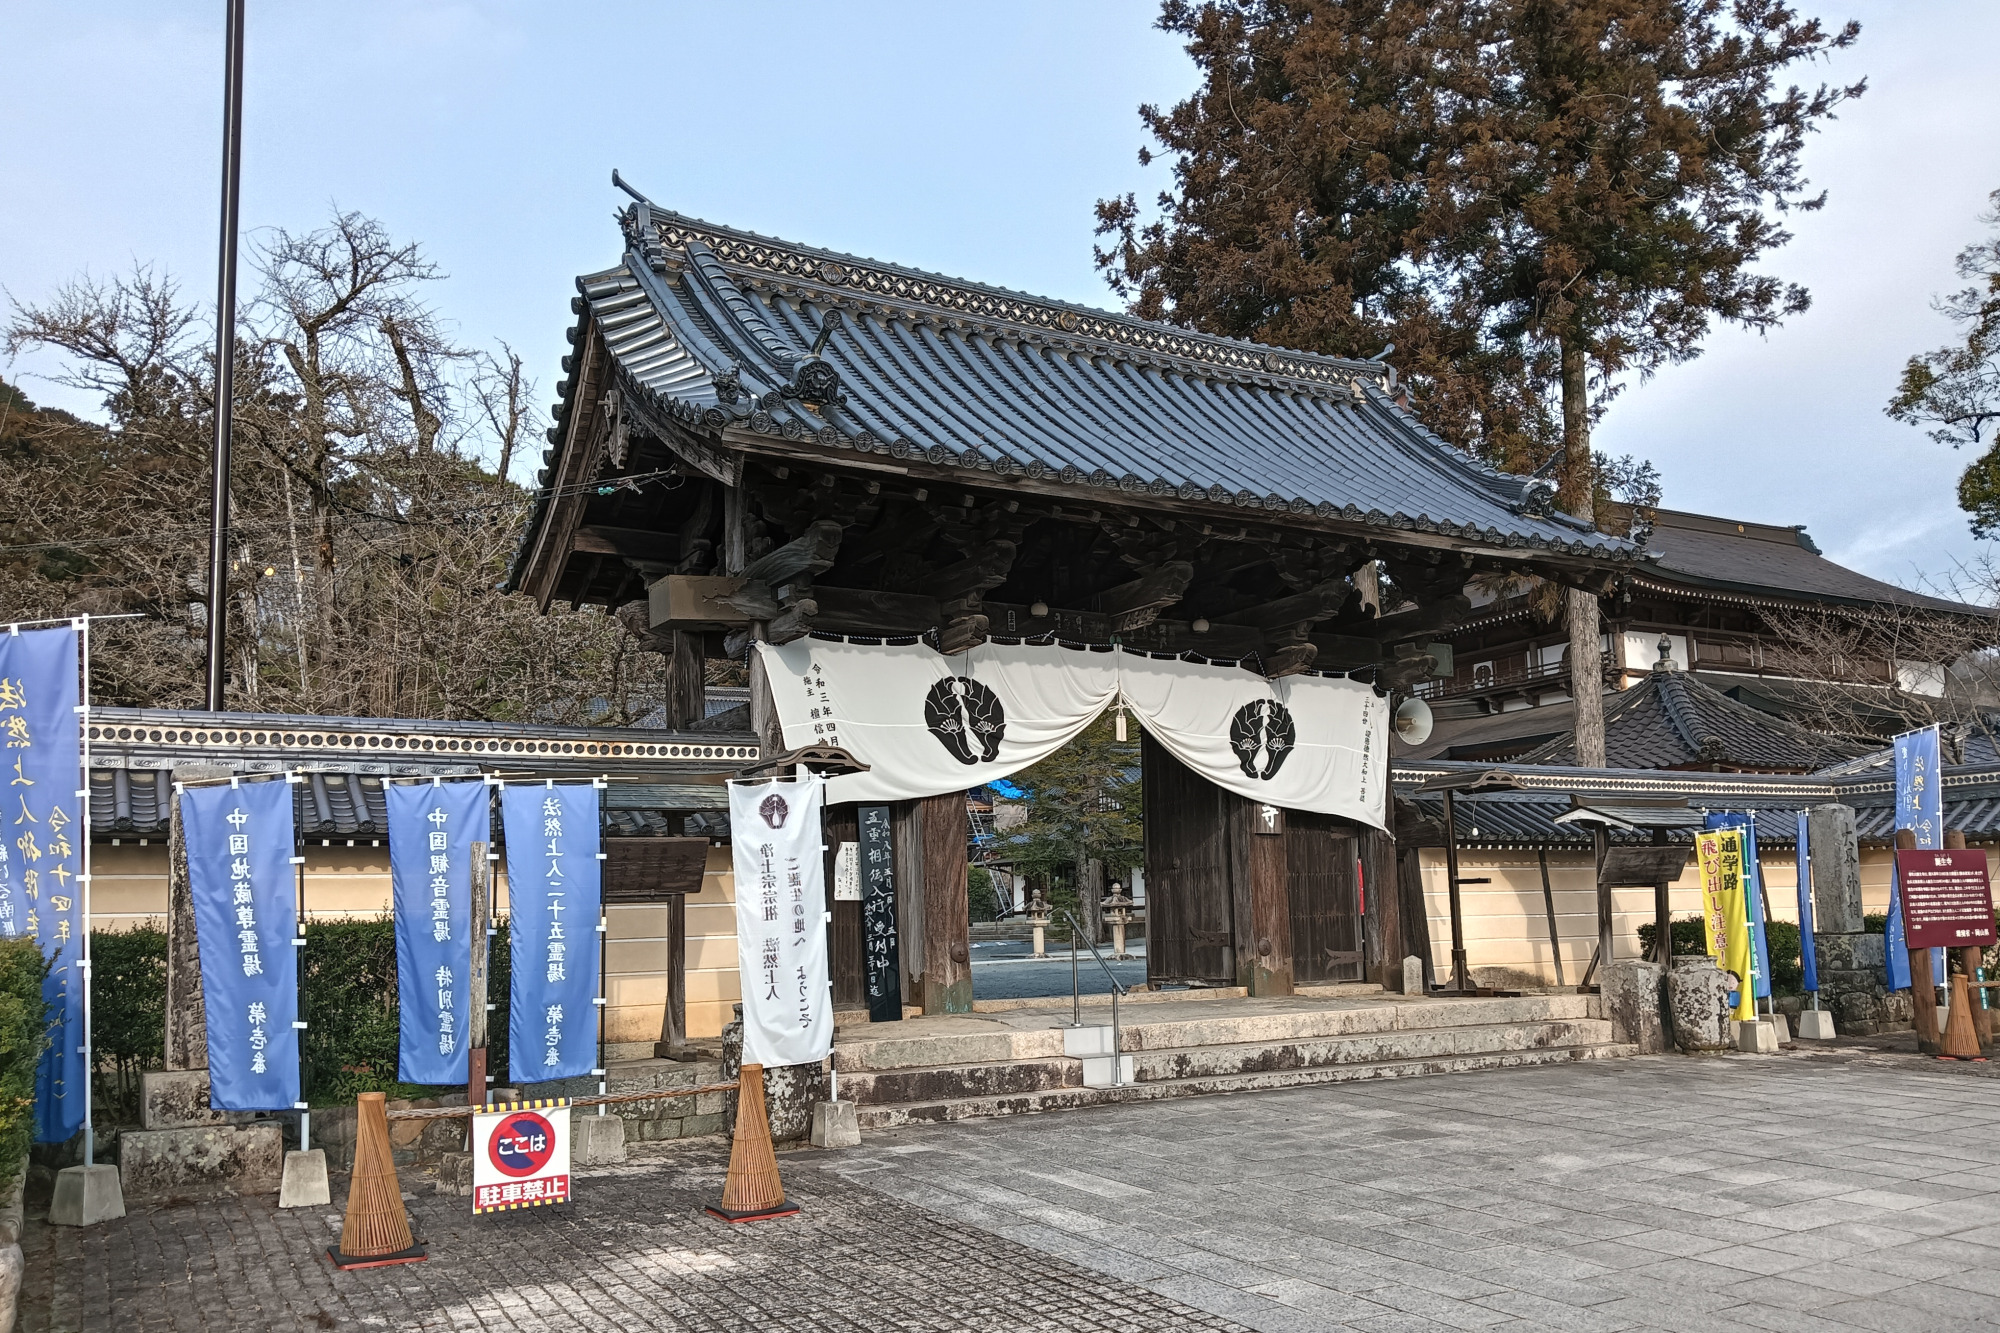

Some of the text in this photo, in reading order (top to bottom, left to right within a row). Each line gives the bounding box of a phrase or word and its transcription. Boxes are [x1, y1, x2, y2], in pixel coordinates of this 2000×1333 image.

[810, 707, 828, 744] 檀信
[811, 662, 840, 747] 令和三年四月
[1720, 835, 1739, 891] 通学路
[1701, 839, 1729, 967] 飛び出し注意！
[873, 920, 890, 979] 受付中
[498, 1134, 546, 1155] ここは
[478, 1177, 566, 1206] 駐車禁止
